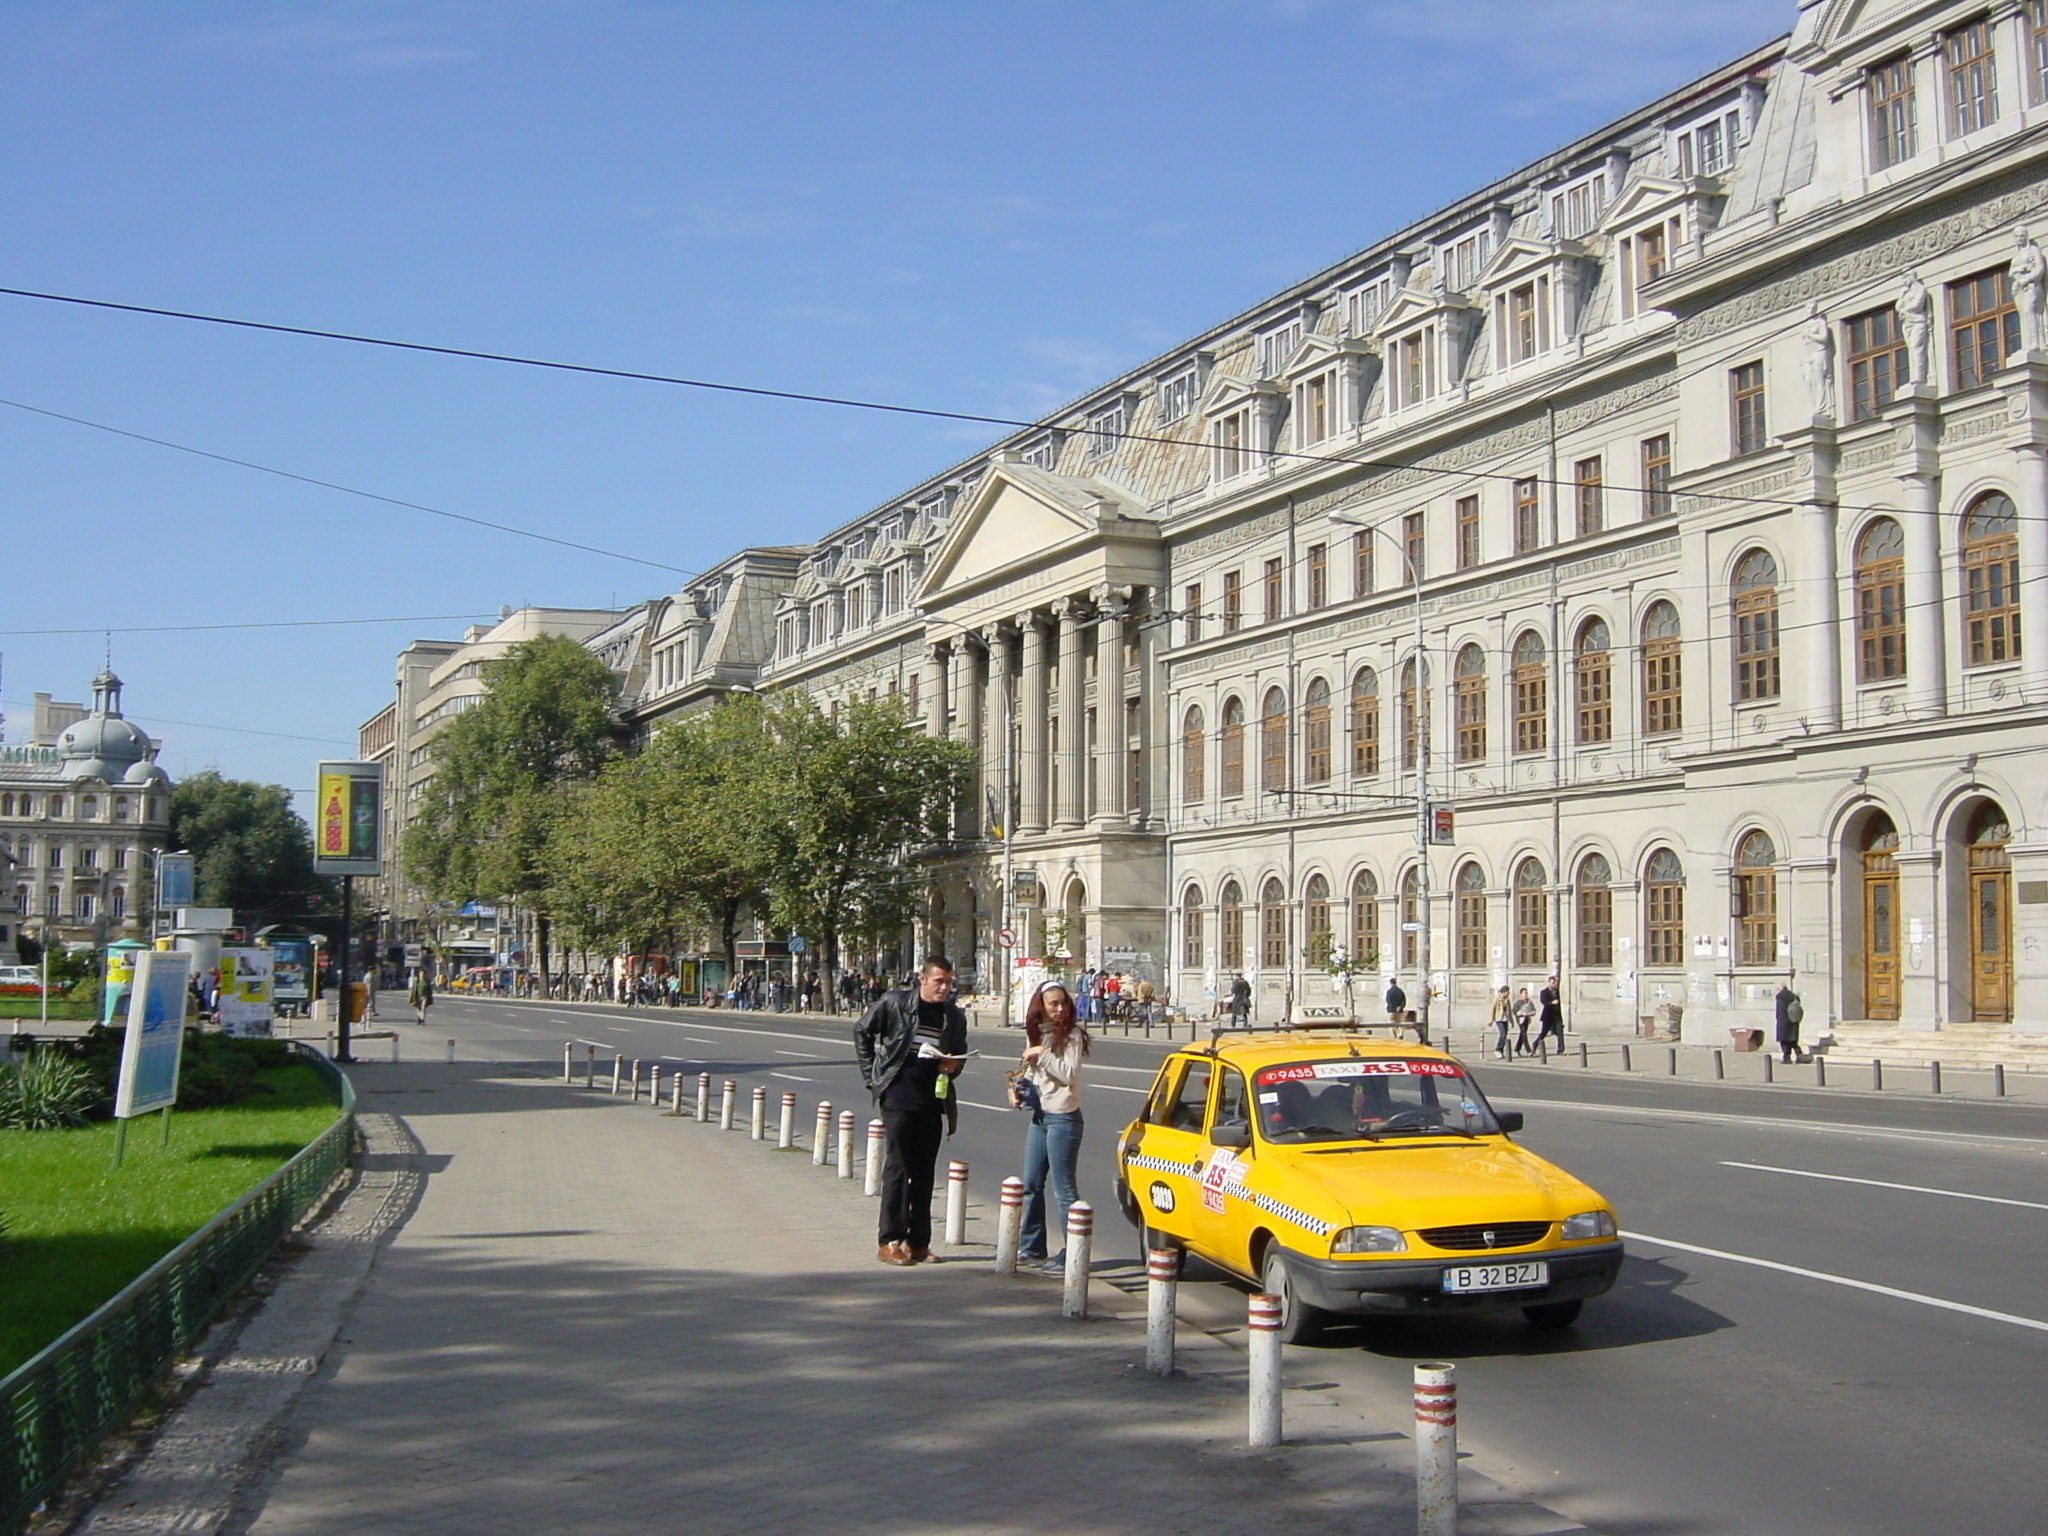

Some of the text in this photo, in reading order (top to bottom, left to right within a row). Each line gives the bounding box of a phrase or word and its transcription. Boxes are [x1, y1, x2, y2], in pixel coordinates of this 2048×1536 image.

[0, 746, 60, 763] ASINOS
[1303, 1008, 1343, 1016] TAXI
[1277, 1067, 1313, 1079] 9435
[1317, 1063, 1406, 1075] TAXI AS
[1421, 1064, 1454, 1075] 9435
[1205, 1163, 1227, 1188] AS
[1458, 1263, 1540, 1288] B 32 BZJ
